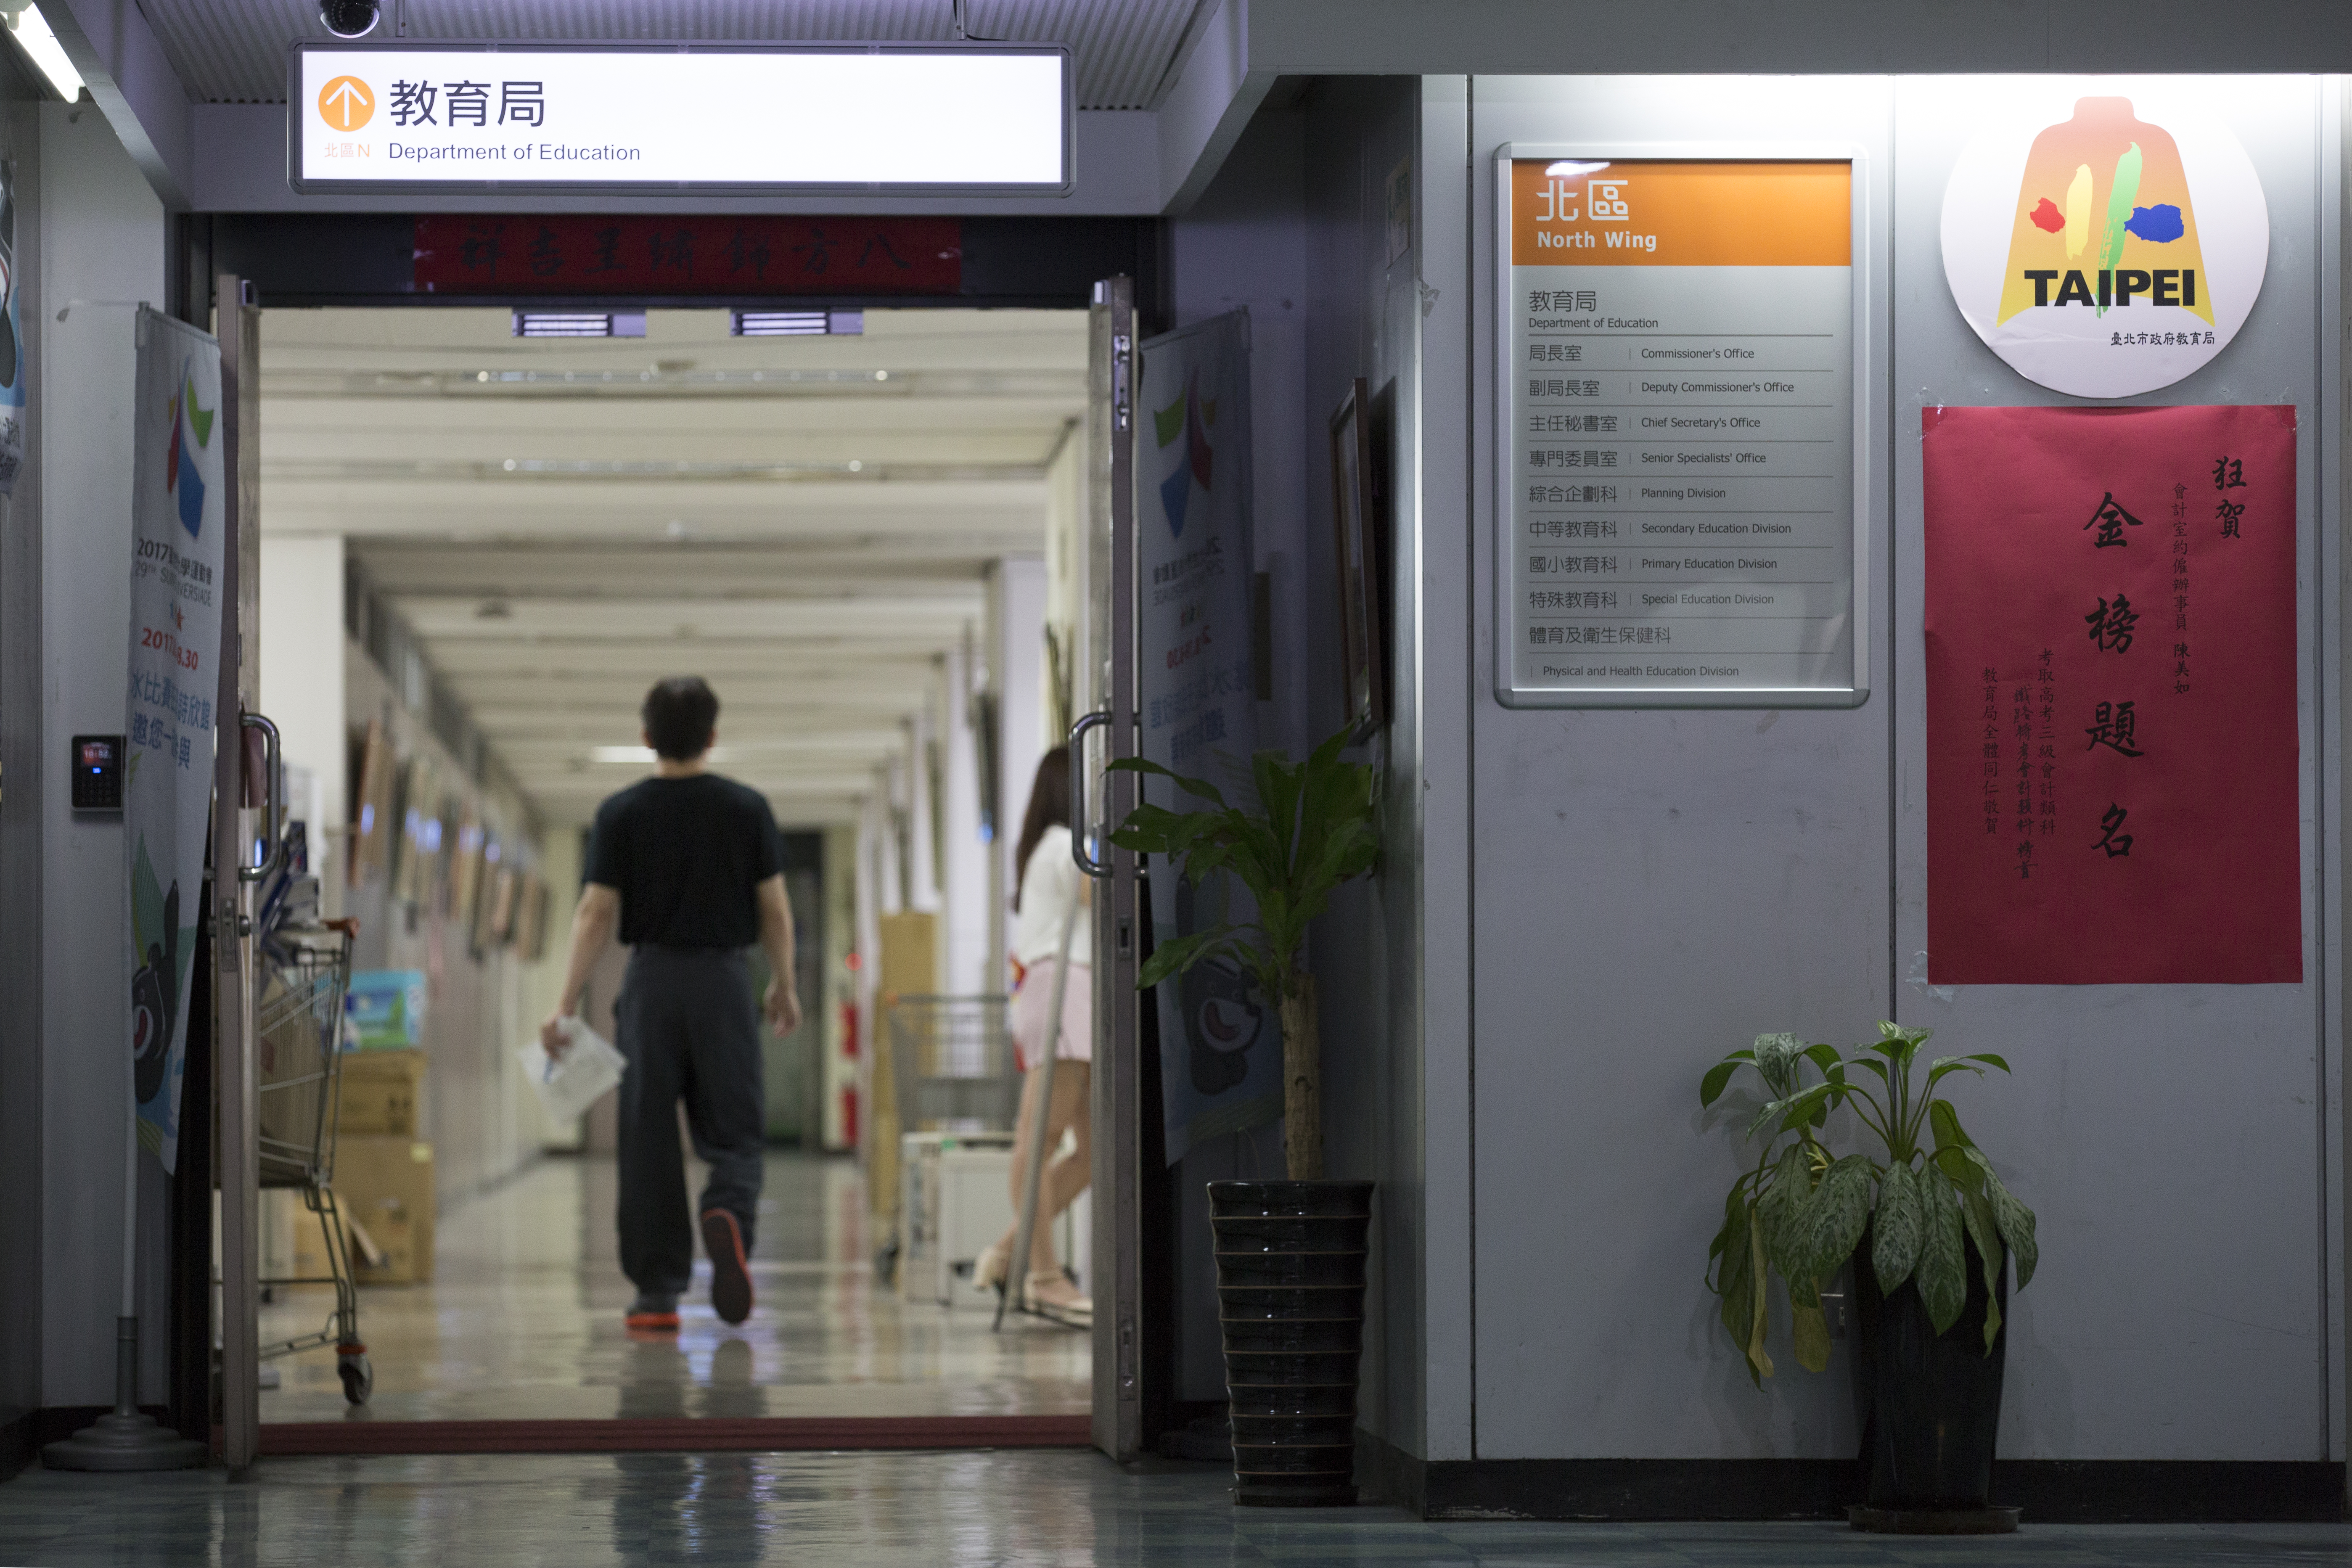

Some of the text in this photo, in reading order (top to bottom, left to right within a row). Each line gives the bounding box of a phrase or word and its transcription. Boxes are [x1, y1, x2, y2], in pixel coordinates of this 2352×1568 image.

[390, 79, 544, 127] 教育局
[389, 143, 640, 163] Department of Education
[1536, 180, 1629, 221] 北區
[1538, 231, 1656, 252] North Wing
[2024, 270, 2195, 307] TAIPEI
[1529, 290, 1596, 312] 教育局
[1529, 317, 1659, 330] Department of Education
[2111, 331, 2215, 346] 臺北市政府教育局
[1529, 344, 1582, 362] 局長室
[1641, 348, 1754, 359] Commissioner's Office
[1529, 379, 1600, 397] 副局長室
[1642, 382, 1794, 394] Deputy Commissioner's Office
[1529, 415, 1617, 432] 主任秘書室
[1641, 417, 1761, 430] Chief Secretary's Office
[1529, 450, 1618, 468] 專門委員室
[1641, 452, 1766, 465] Senior Specialists' Office
[1529, 485, 1618, 503] 綜合企劃科
[1641, 488, 1726, 500] Planning Division
[2212, 455, 2247, 539] 狂賀
[1529, 521, 1618, 538] 中等教育科
[1642, 523, 1791, 536] Secondary Education Division
[1529, 555, 1618, 574] 國小教育科
[1642, 558, 1777, 571] Primary Education Division
[1529, 591, 1618, 609] 特殊教育科
[1642, 594, 1774, 606] Special Education Division
[1529, 626, 1671, 644] 體育及衛生保健科
[1543, 666, 1739, 678] Physical and Health Education Division
[2082, 492, 2145, 859] 金榜題名
[2173, 642, 2191, 696] 陳美如
[1982, 666, 2000, 835] 教育局全體同仁敬賀
[2038, 648, 2056, 836] 考取高考三級會計類科
